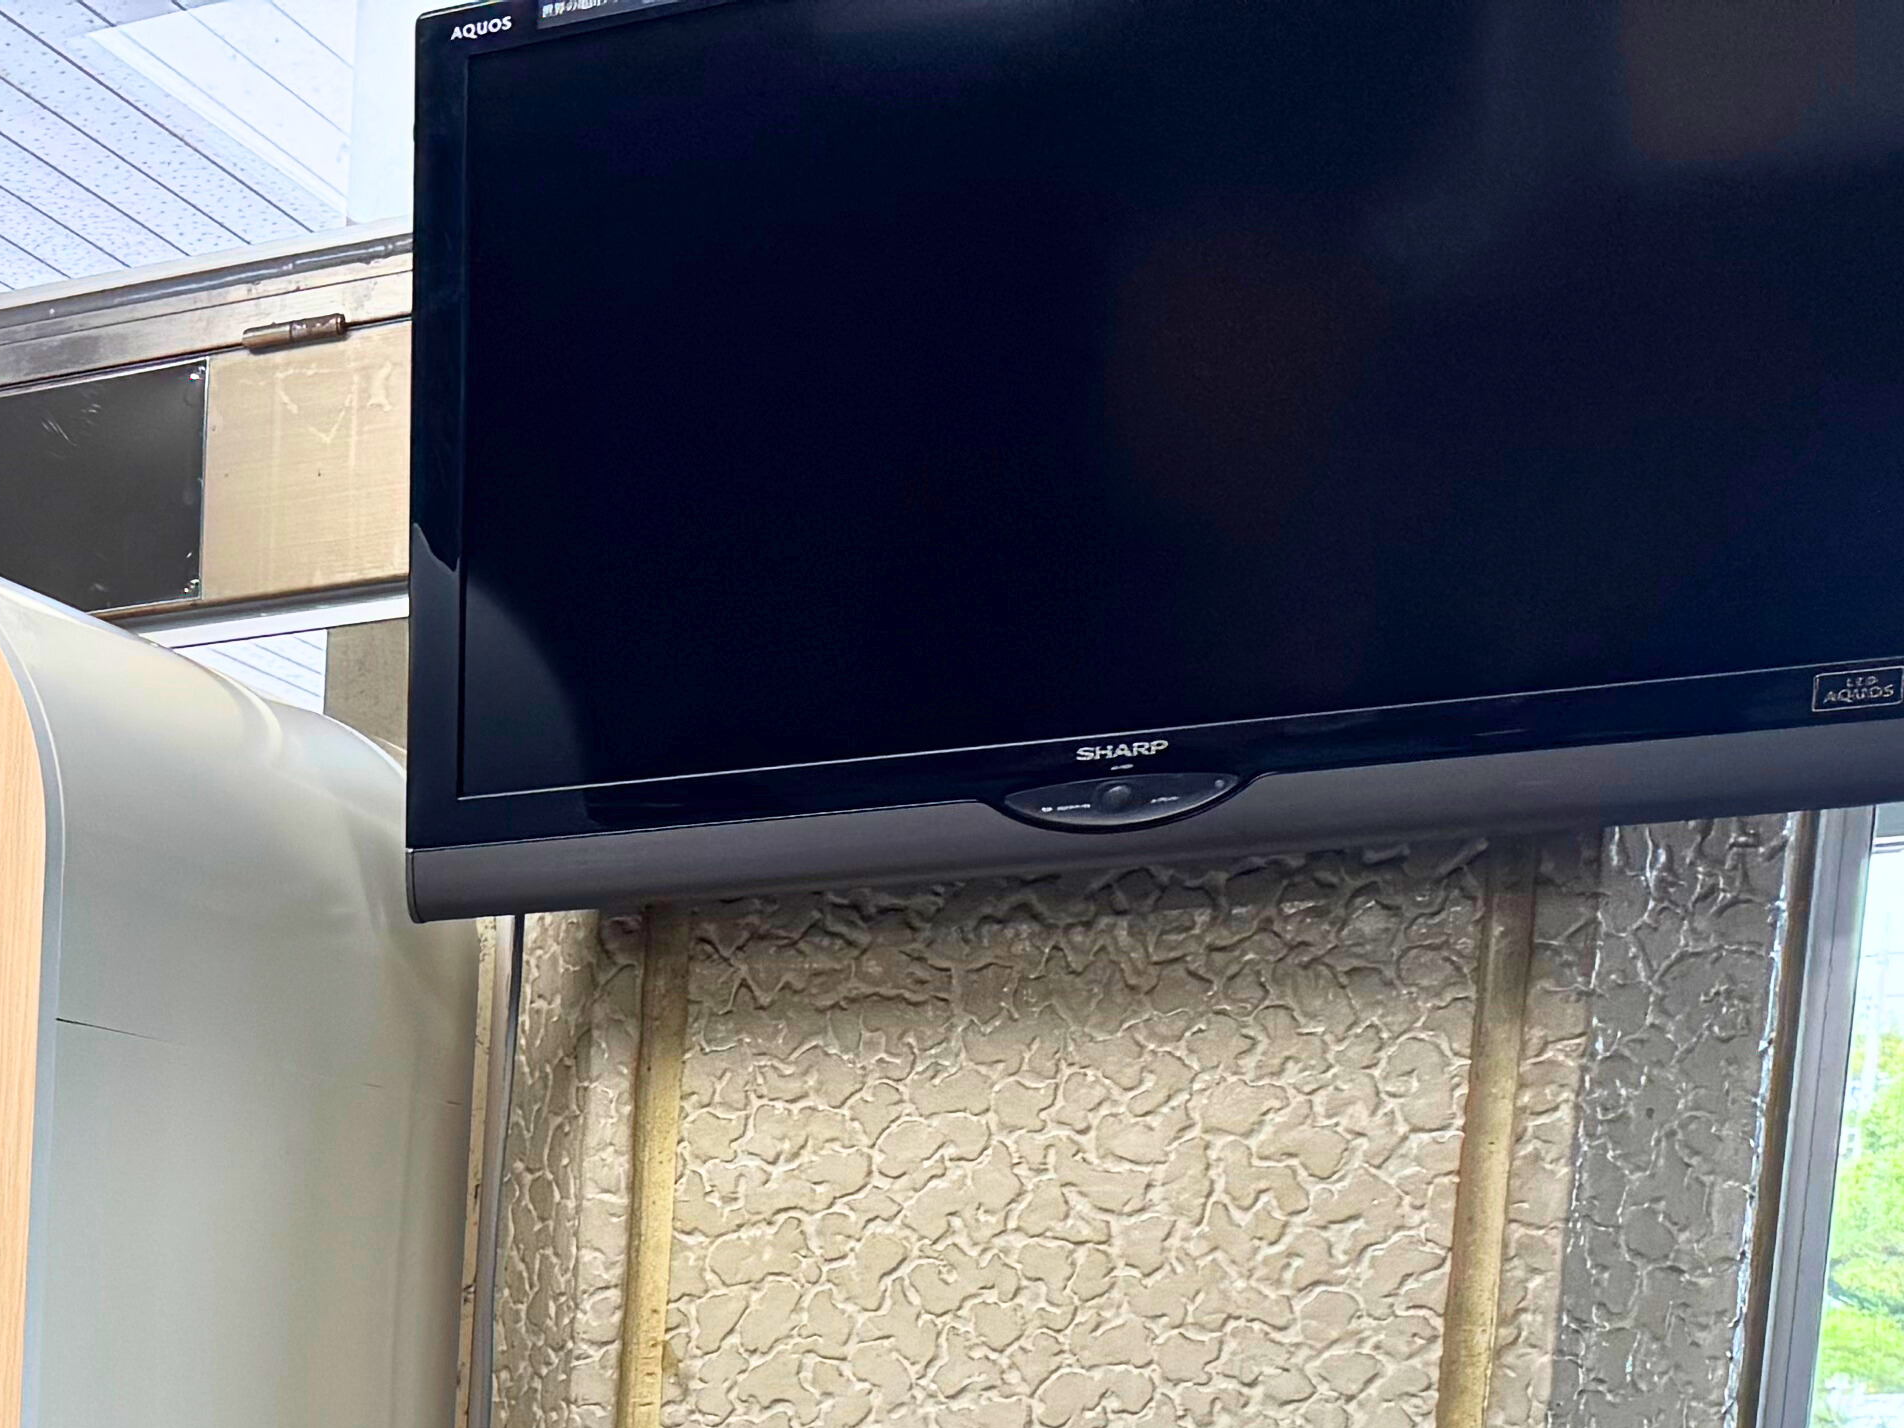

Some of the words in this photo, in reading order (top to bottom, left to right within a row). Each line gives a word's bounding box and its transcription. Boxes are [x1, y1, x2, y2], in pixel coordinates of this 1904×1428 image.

[450, 15, 512, 40] AQUOS
[1823, 683, 1894, 703] AQUOS
[1076, 740, 1169, 761] SHARP
